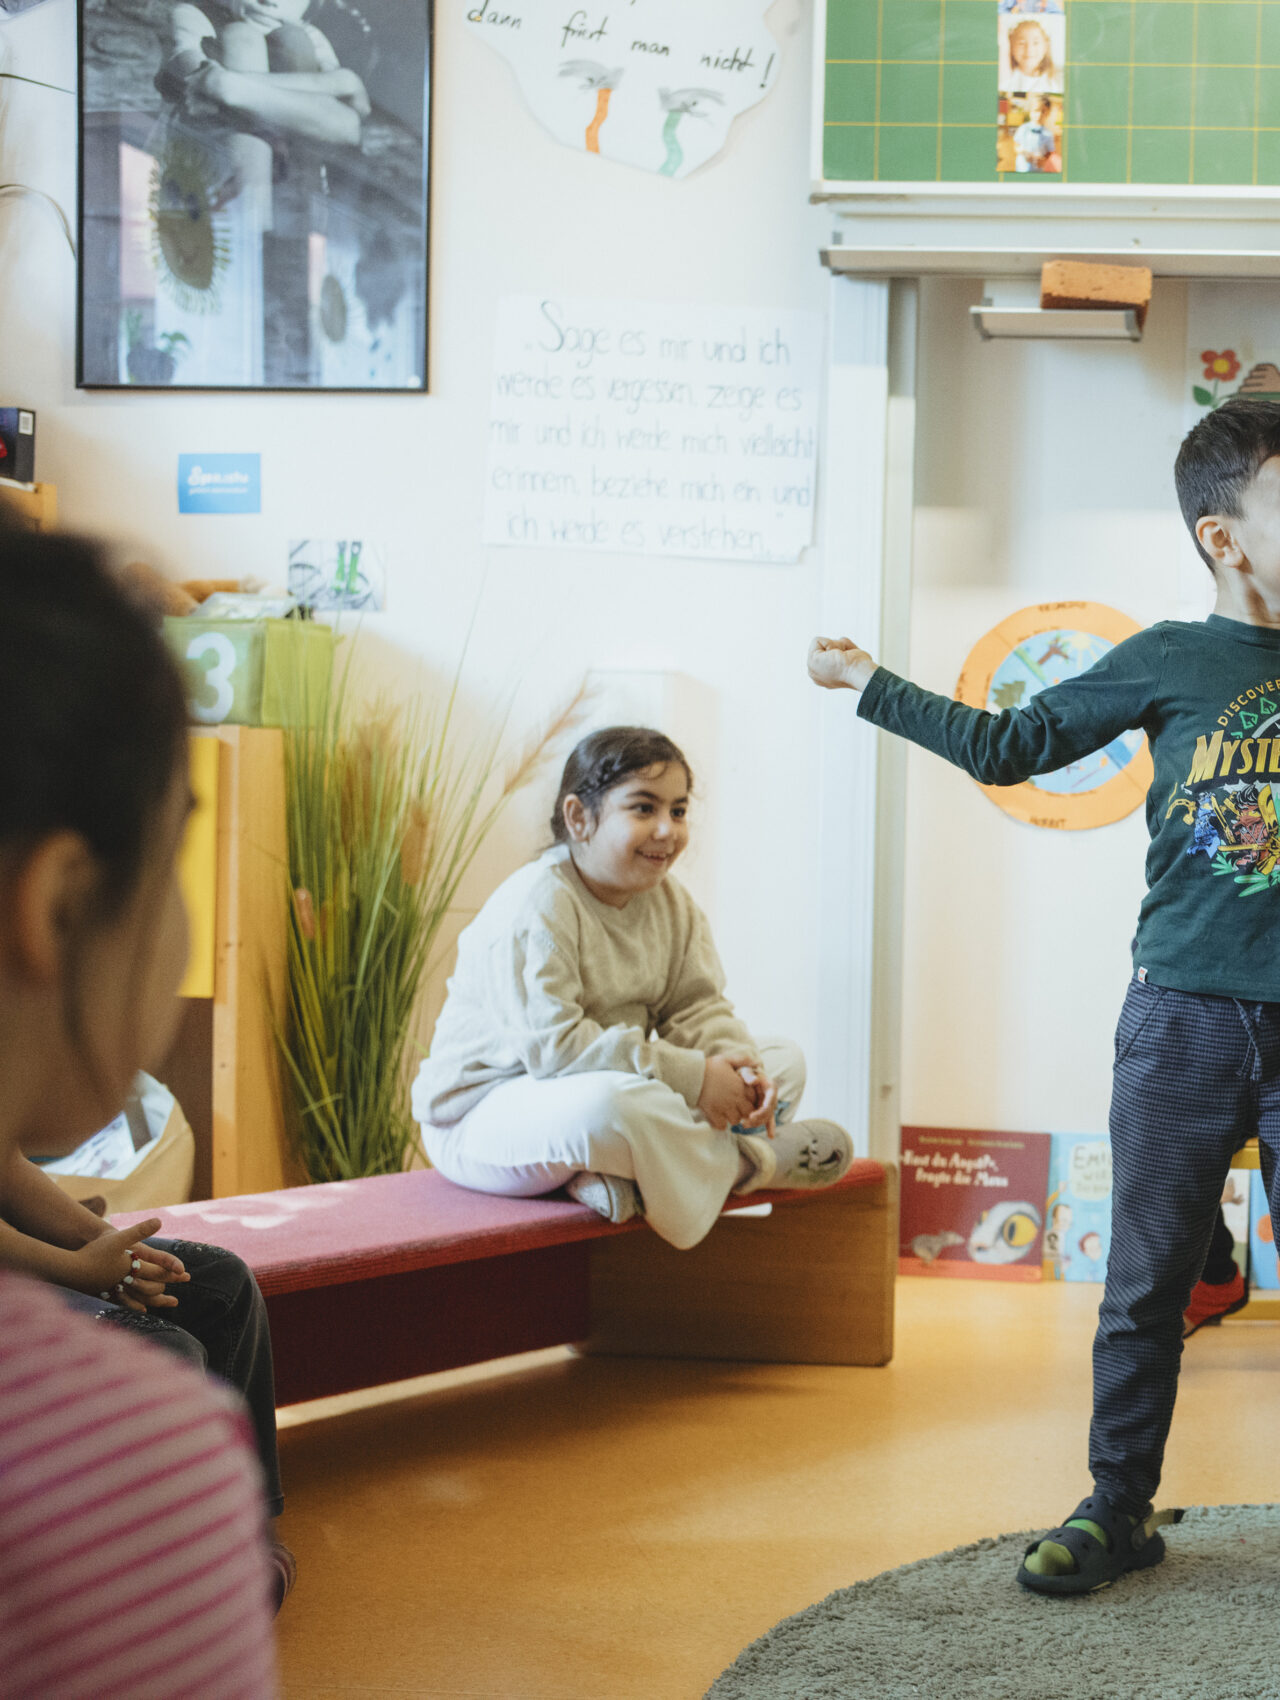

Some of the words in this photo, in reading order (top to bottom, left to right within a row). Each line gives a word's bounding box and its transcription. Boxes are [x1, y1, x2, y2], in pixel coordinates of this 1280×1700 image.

[467, 0, 522, 30] dann
[631, 39, 670, 56] man
[620, 329, 646, 356] es
[660, 334, 691, 362] mir
[703, 326, 747, 364] und
[759, 326, 792, 366] ich
[497, 362, 561, 399] werde
[571, 373, 597, 401] es
[707, 383, 766, 422] zeige
[777, 385, 803, 412] es
[490, 416, 521, 446] mir
[535, 412, 573, 448] und
[581, 412, 605, 449] ich
[616, 417, 672, 452] werde
[681, 422, 728, 455] mich
[592, 463, 669, 499] beziehe
[681, 473, 725, 503] mich
[733, 477, 761, 505] ein
[773, 472, 811, 508] und
[506, 503, 539, 543] ich
[550, 505, 609, 546] werde
[620, 519, 646, 548] es
[186, 631, 237, 724] 3
